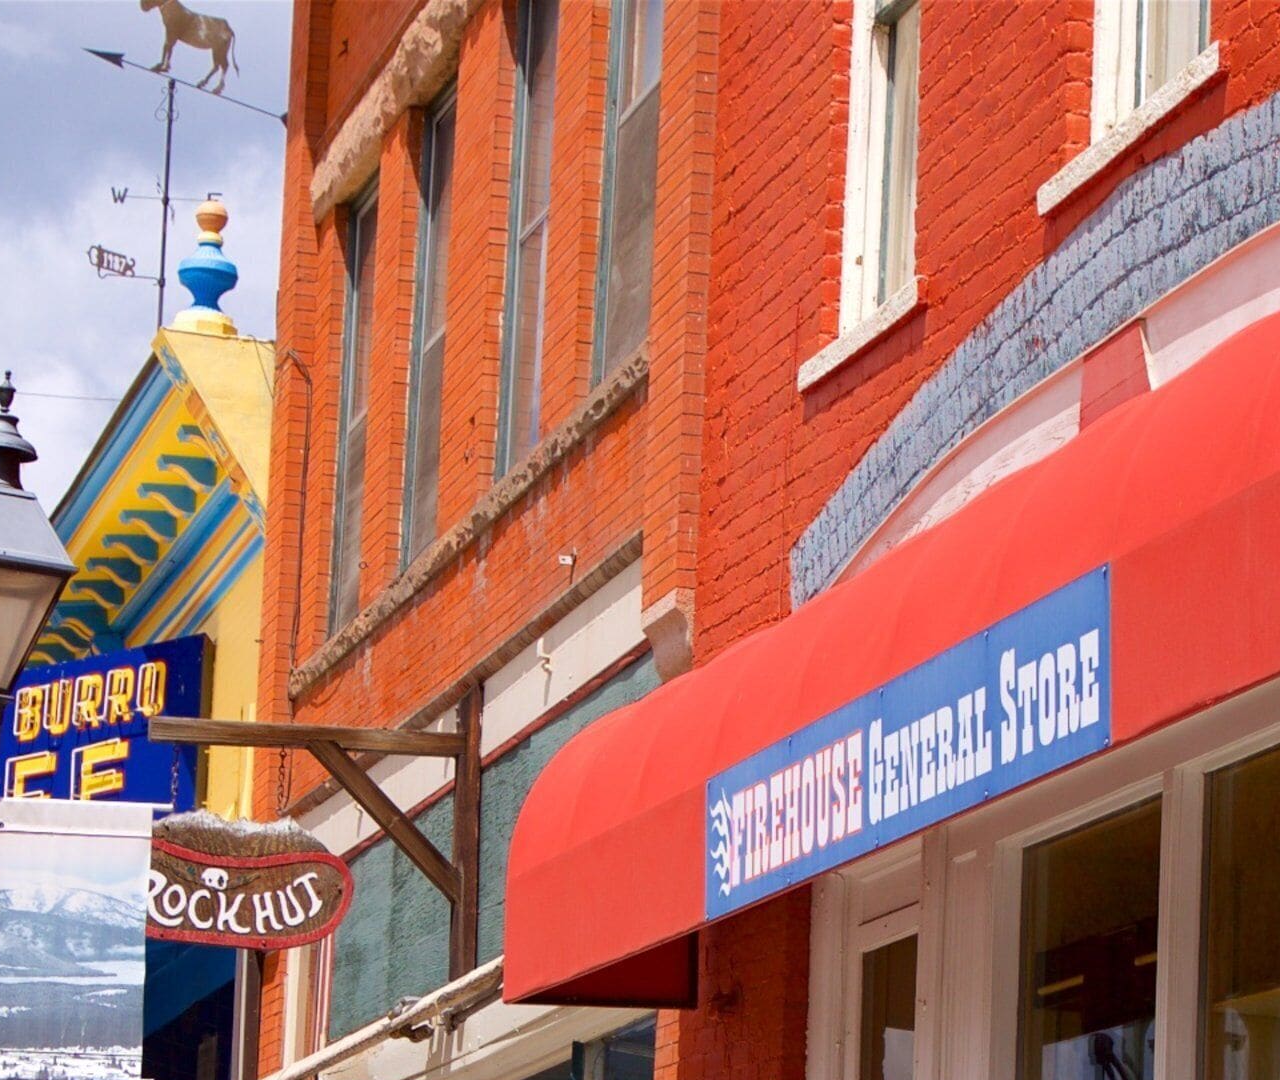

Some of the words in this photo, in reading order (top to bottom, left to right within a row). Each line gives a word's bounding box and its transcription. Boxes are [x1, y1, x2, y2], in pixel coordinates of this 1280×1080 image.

[111, 187, 128, 204] W
[13, 660, 167, 742] BURRO
[730, 729, 863, 888] FIREHOUSE
[868, 686, 992, 826] GENERAL
[999, 628, 1099, 766] STORE
[147, 868, 251, 934] ROCK
[252, 871, 323, 934] HUT
